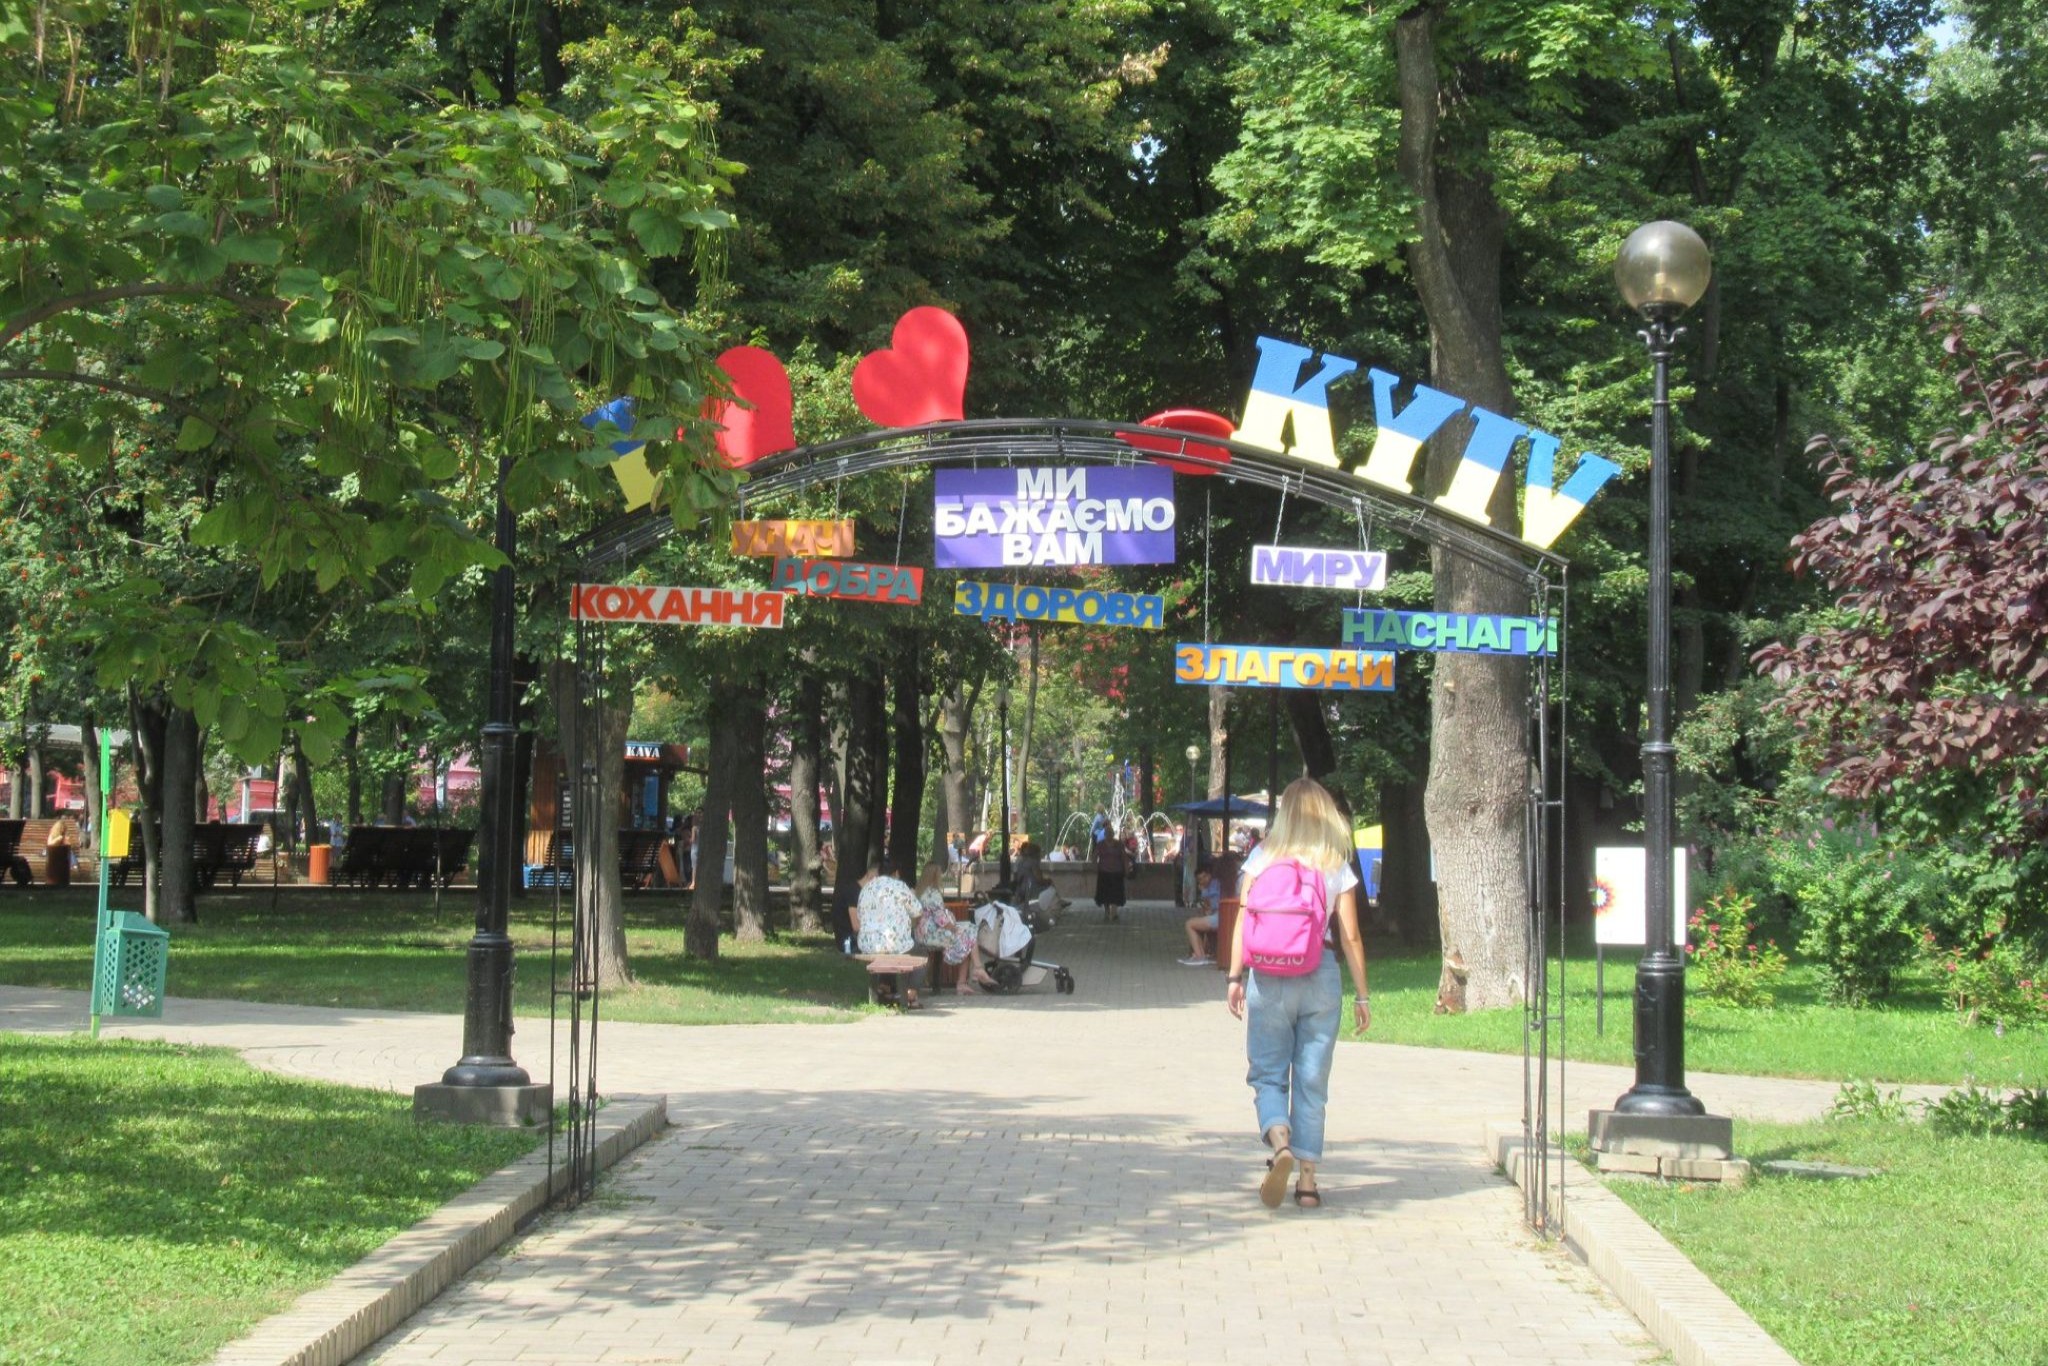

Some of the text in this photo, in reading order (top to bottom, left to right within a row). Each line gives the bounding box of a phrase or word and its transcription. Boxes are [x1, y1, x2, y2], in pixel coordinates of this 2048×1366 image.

[1231, 336, 1621, 549] KYIV
[1017, 468, 1086, 499] МИ
[935, 498, 1175, 536] БАЖАЄМО
[1002, 532, 1102, 566] ВАМ
[1255, 549, 1382, 588] МИРУ
[773, 557, 919, 601] ДОБРА
[571, 585, 782, 627] КОХАННЯ
[955, 581, 1164, 629] ЗДОРОВЯ
[1343, 611, 1558, 653] НАСНАГИ
[1175, 647, 1394, 689] ЗЛАГОДИ
